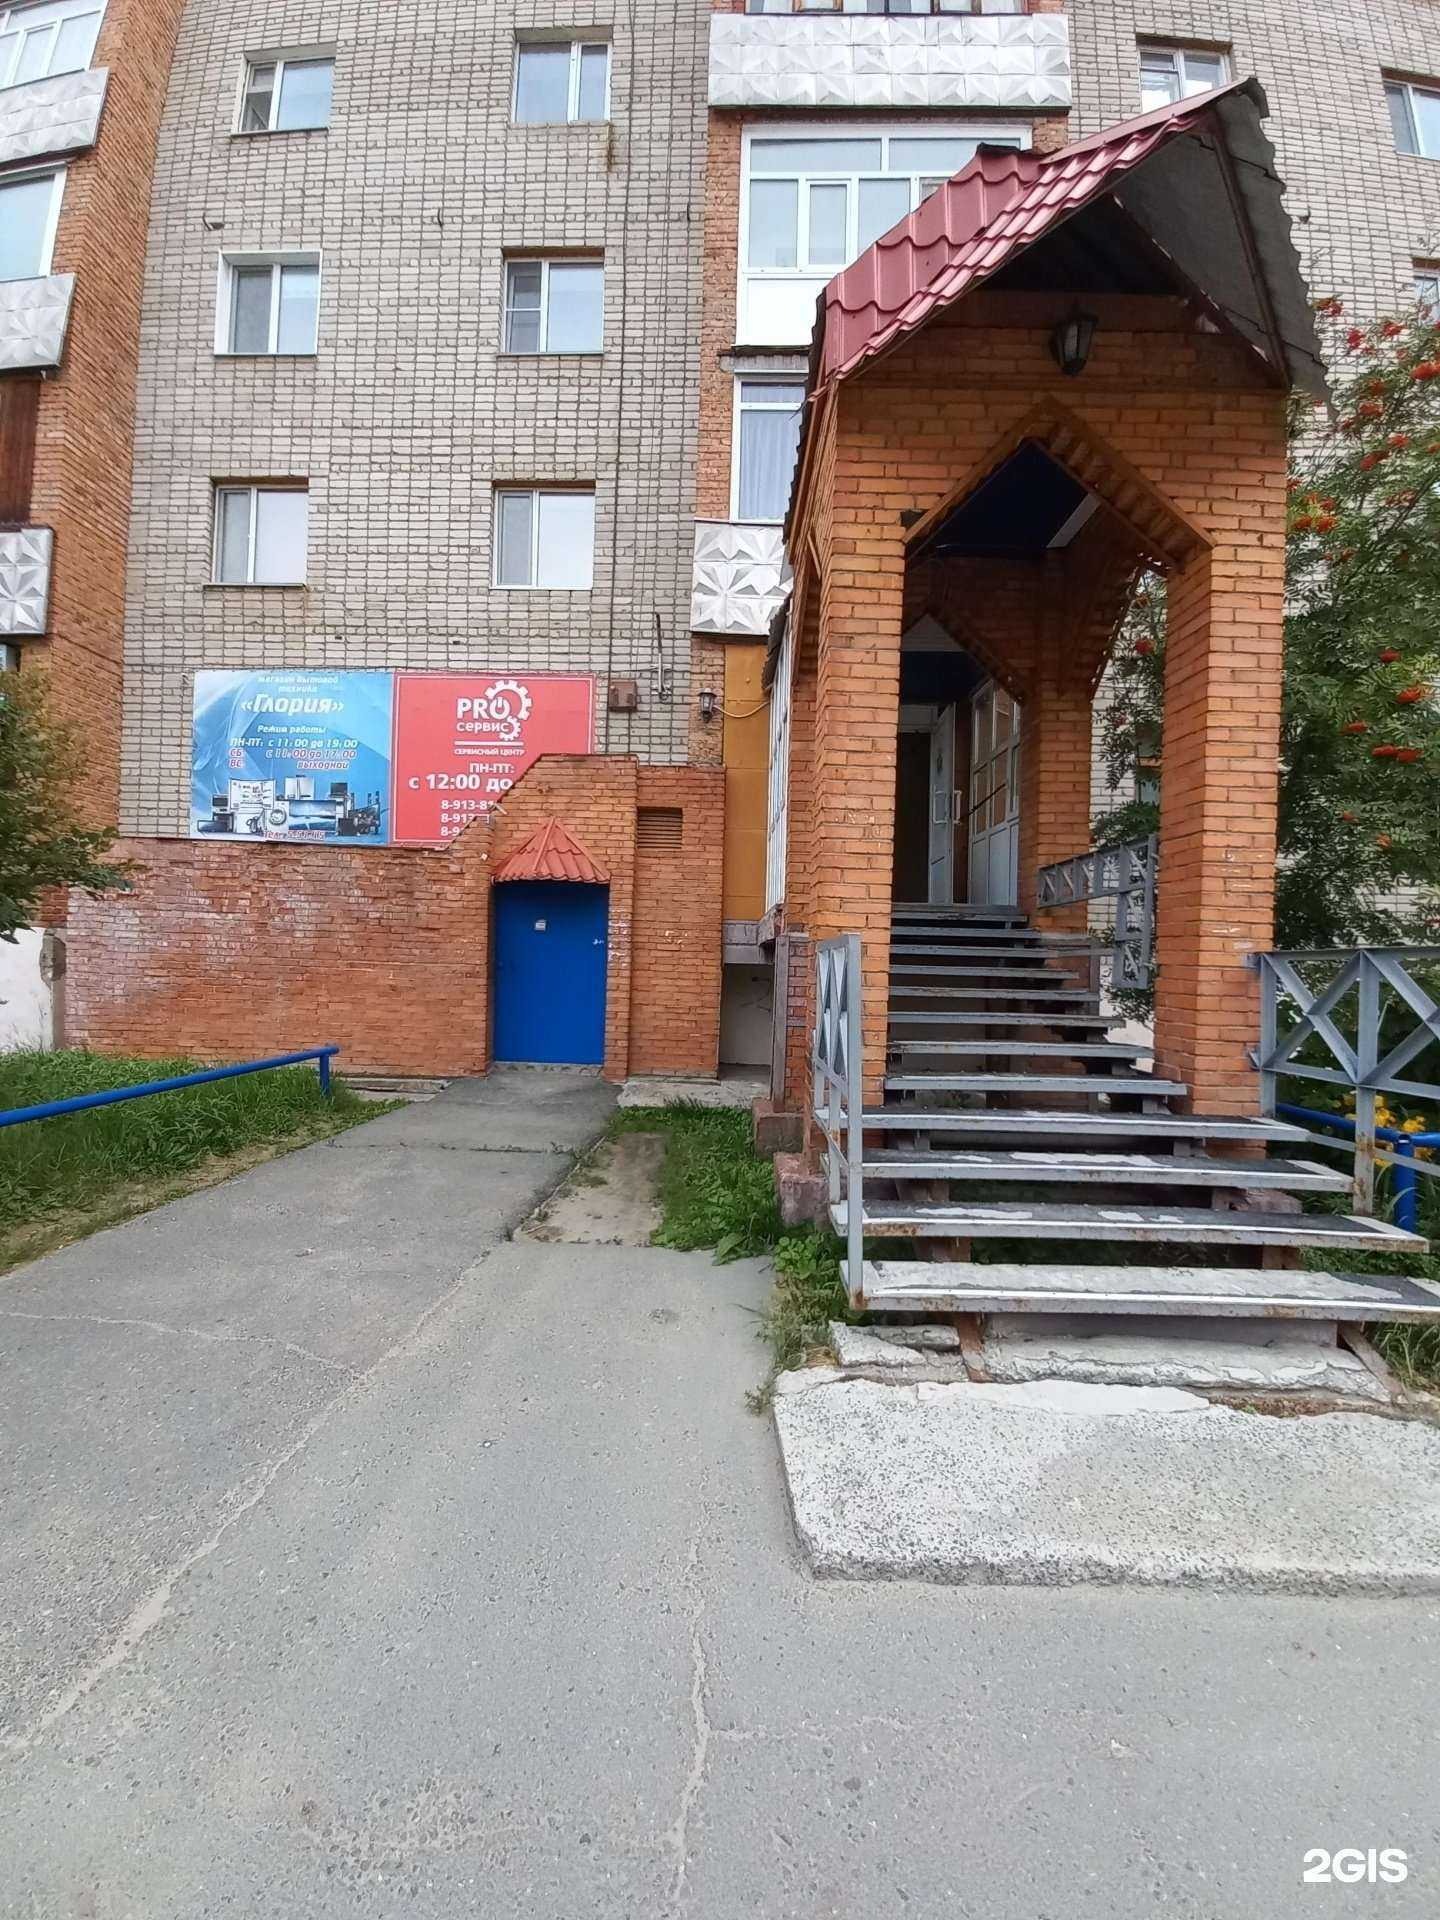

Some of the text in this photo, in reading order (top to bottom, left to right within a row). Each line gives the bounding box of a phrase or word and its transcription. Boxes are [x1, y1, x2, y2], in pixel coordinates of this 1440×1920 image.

[240, 694, 344, 716] «Глория»
[456, 696, 511, 720] PRO
[257, 724, 327, 735] Режим работы
[456, 721, 510, 734] сервис
[230, 737, 264, 748] ПН-ПТ:
[229, 748, 244, 758] СБ
[229, 759, 244, 769] ВС
[469, 762, 515, 774] ПН-ПТ:
[426, 773, 480, 790] 12:00
[486, 777, 514, 793] до
[440, 826, 464, 837] 8-9
